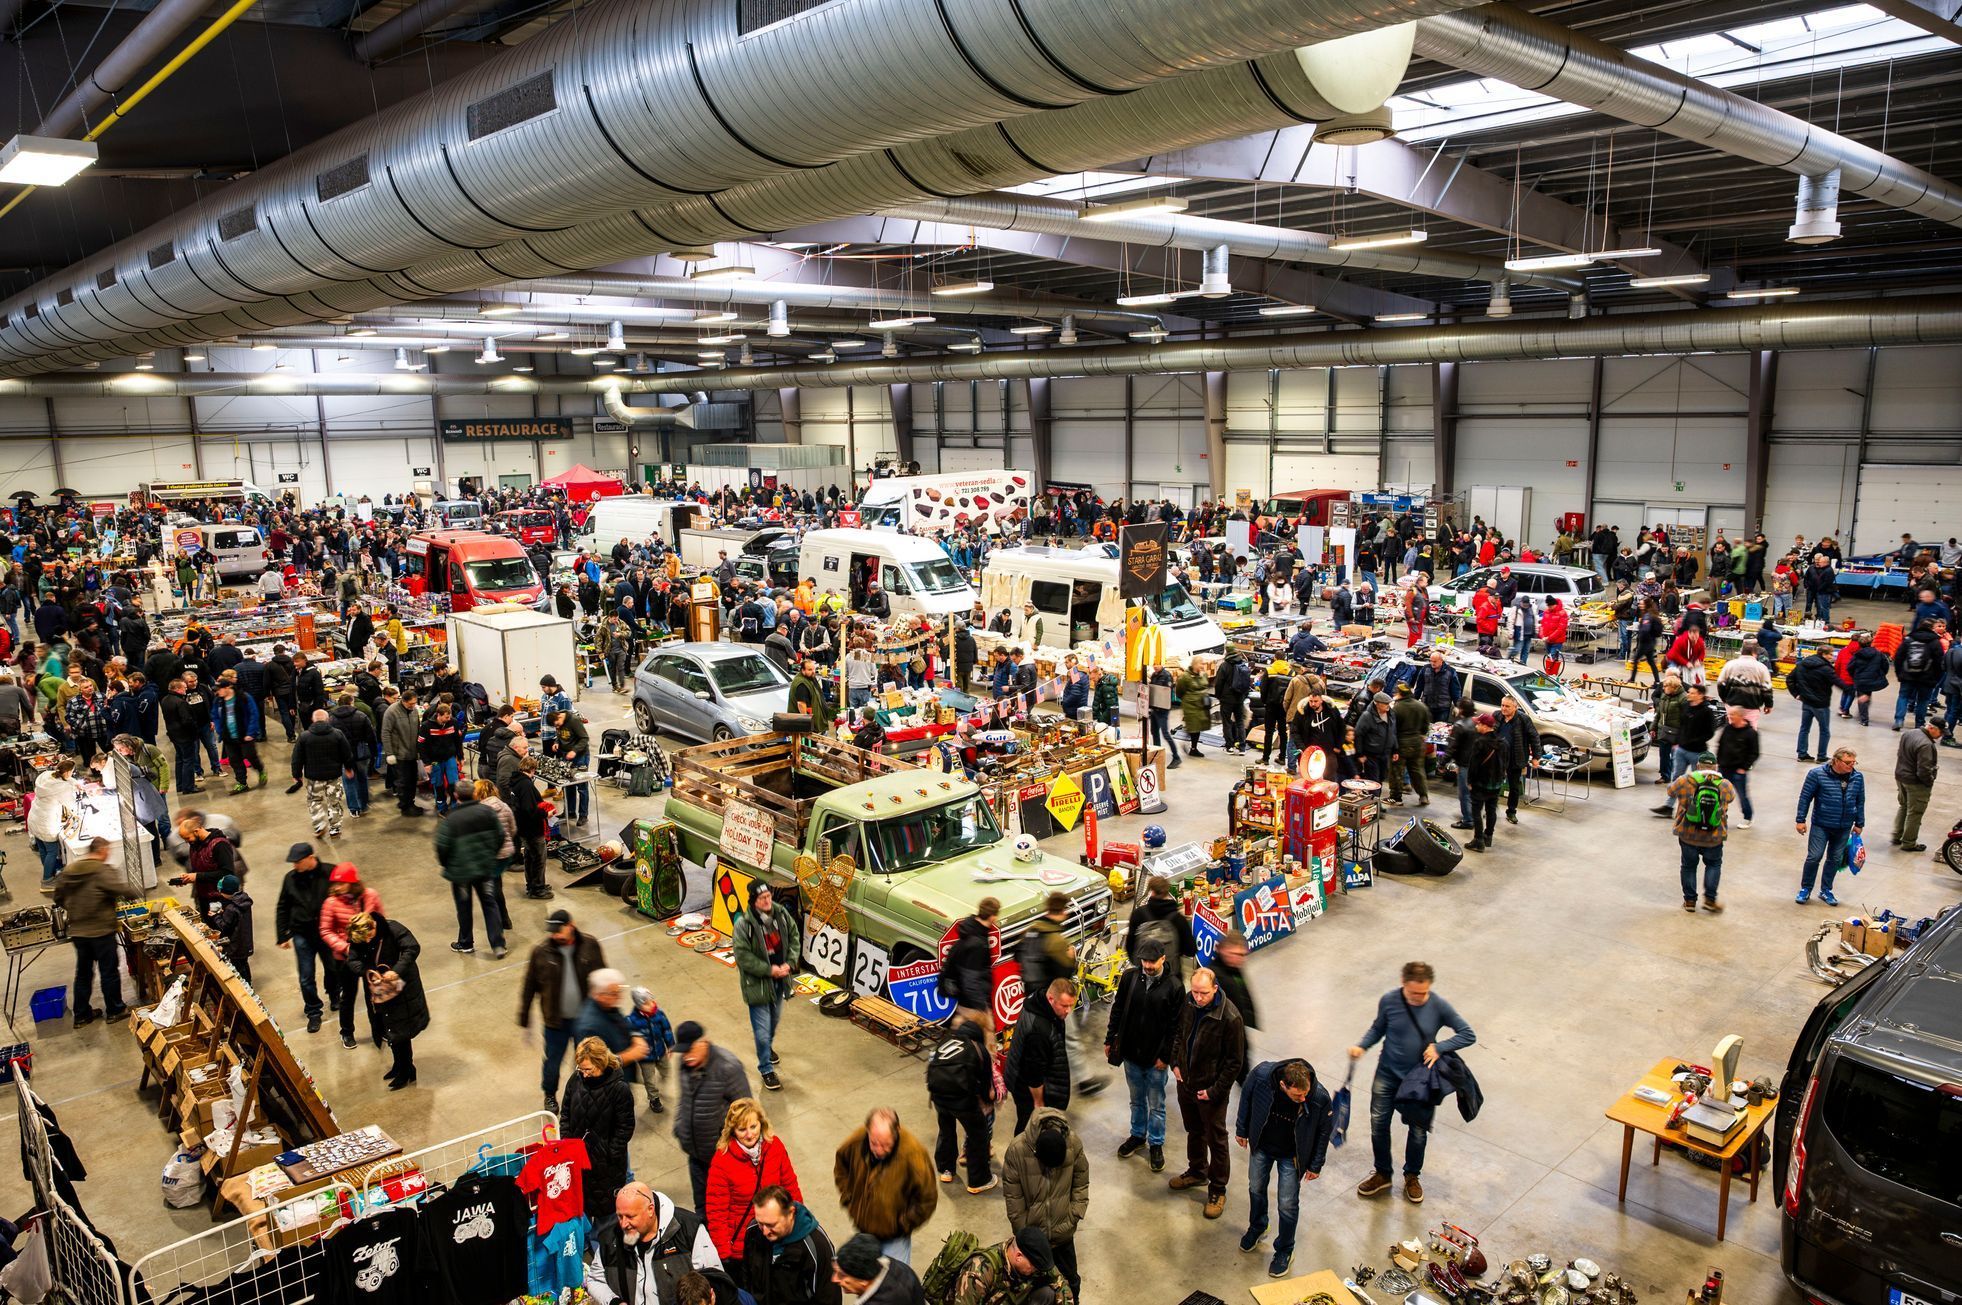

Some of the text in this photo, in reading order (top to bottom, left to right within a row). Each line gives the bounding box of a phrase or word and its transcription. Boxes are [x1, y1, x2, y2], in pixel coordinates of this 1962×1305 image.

[465, 424, 557, 437] RESTAURACE
[1090, 773, 1104, 802] P
[1051, 792, 1081, 807] PIRELLI
[732, 813, 747, 825] CHECK
[749, 820, 762, 830] YOUR
[725, 826, 752, 846] HOLIDAY
[755, 839, 769, 852] TRIP
[1183, 851, 1198, 860] WA
[1346, 873, 1370, 883] ALPA
[1200, 907, 1225, 931] INTERSTATE
[1242, 899, 1292, 932] OTTA
[1293, 901, 1321, 920] Mobiloil
[1248, 932, 1273, 950] MÝDLO
[855, 952, 882, 992] 25
[897, 963, 940, 979] INTERSTAT
[909, 977, 938, 987] CALIFORNIA
[453, 1201, 496, 1224] JAWA
[1814, 1207, 1873, 1237] TOURNEO
[352, 1236, 402, 1263] Zetor
